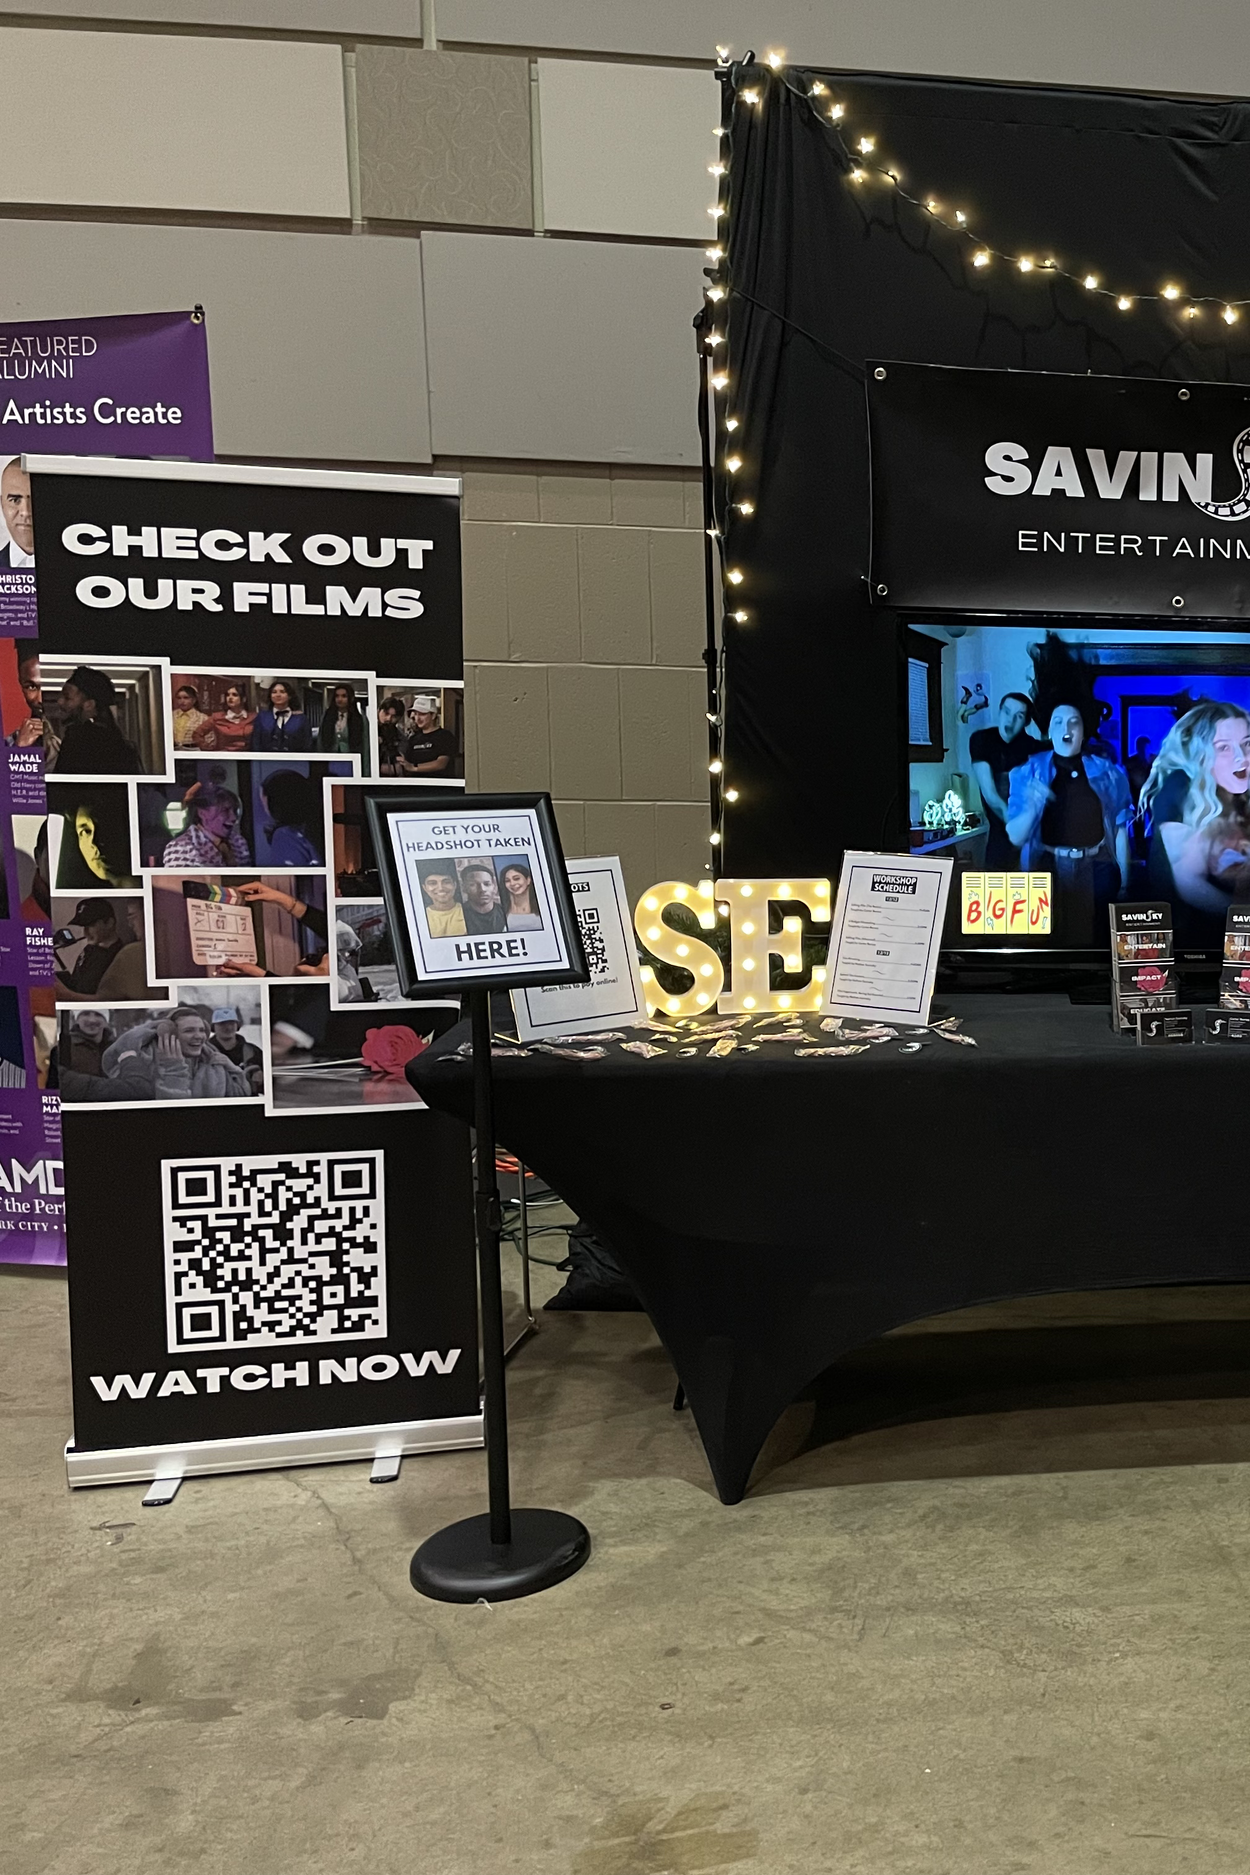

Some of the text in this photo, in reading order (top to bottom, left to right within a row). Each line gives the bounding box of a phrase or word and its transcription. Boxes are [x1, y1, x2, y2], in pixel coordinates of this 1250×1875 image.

[0, 357, 74, 379] LUMNI
[2, 397, 183, 425] Artists Create
[61, 522, 434, 570] CHECK OUT
[75, 575, 425, 619] OUR FILMS
[8, 754, 42, 763] JAMAL
[8, 764, 39, 773] WADE
[432, 824, 501, 836] GET YOUR
[406, 837, 532, 852] HEADSHOT TAKEN
[874, 875, 917, 885] WORKSHOP
[874, 884, 913, 894] SCHEDULE
[967, 890, 1006, 924] BIG
[1121, 910, 1163, 922] SAVINSKY
[26, 927, 44, 936] RAY
[455, 938, 528, 962] HERE!
[634, 878, 830, 1018] SE
[582, 981, 595, 989] pay
[596, 977, 618, 986] online!
[4, 1197, 31, 1213] the
[18, 1221, 49, 1232] CITY
[90, 1348, 462, 1402] WATCH NOW
